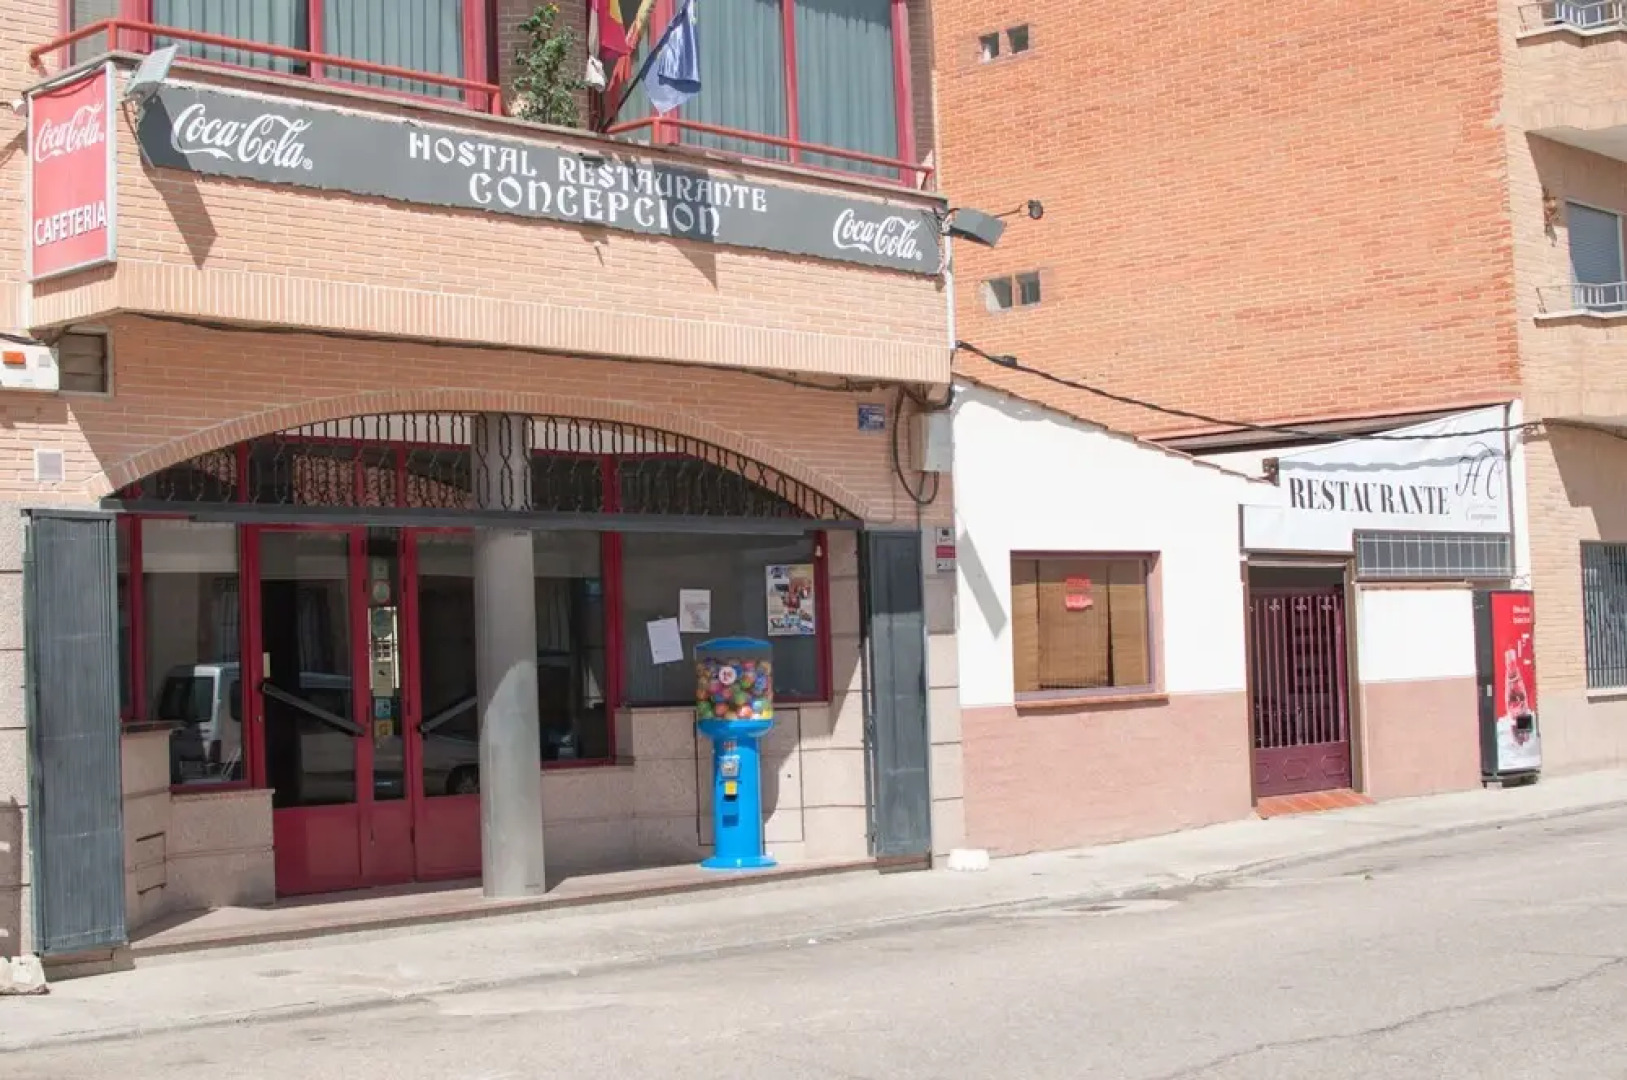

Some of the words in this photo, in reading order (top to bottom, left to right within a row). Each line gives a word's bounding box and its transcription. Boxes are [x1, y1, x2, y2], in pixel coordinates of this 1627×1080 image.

[408, 131, 537, 177] HOSTAL
[558, 159, 767, 212] RESTAURANTE
[34, 205, 108, 247] CAFETERIA
[1289, 477, 1450, 515] RESTAURANTE
